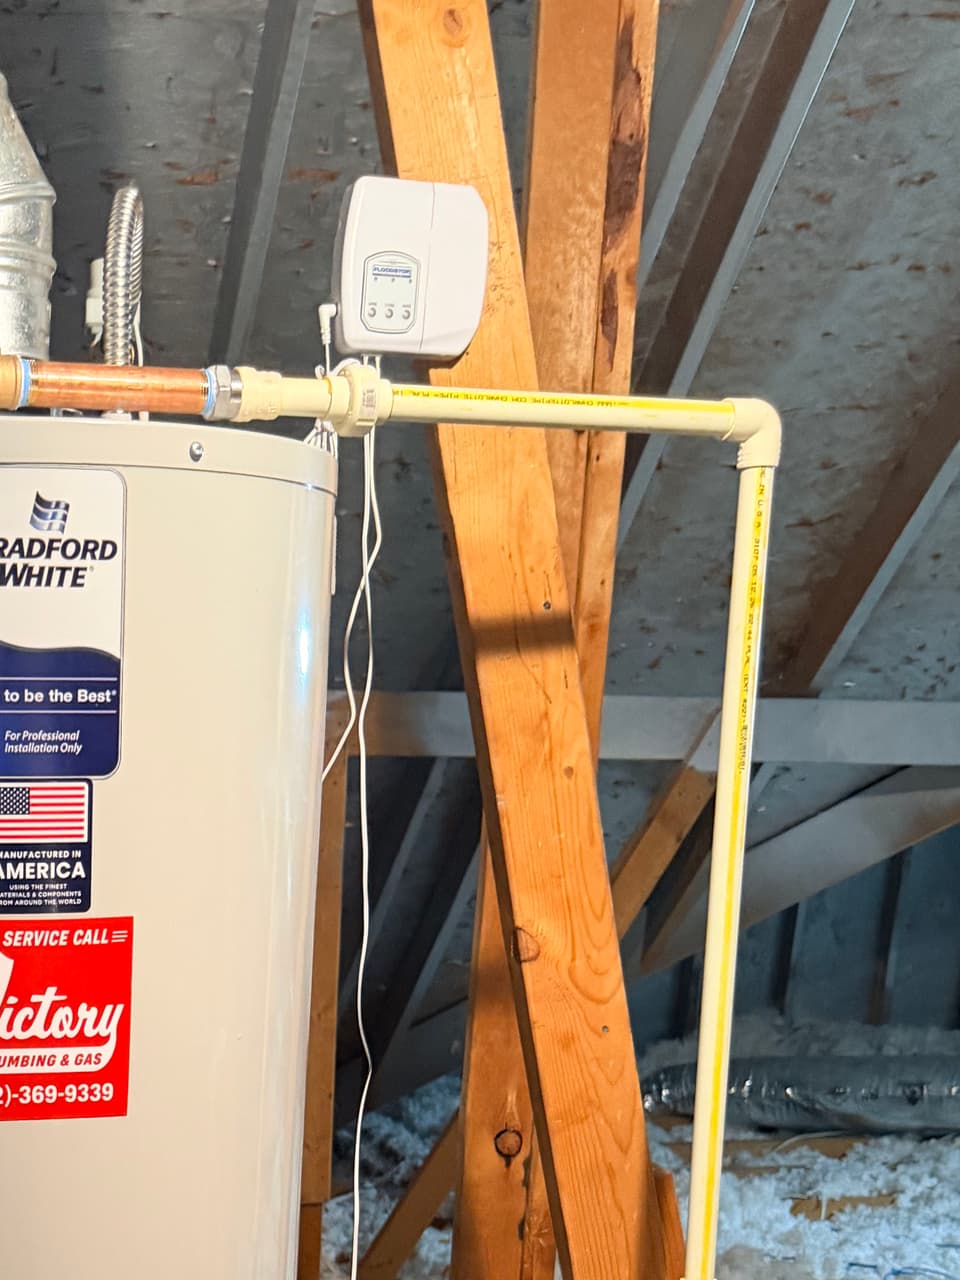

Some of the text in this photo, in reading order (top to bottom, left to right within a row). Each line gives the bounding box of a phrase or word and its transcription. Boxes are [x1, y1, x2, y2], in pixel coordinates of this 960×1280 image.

[4, 690, 20, 702] to
[24, 689, 44, 702] be
[48, 689, 73, 702] the
[4, 730, 80, 741] For Professional
[4, 742, 82, 755] Installation Only
[2, 930, 70, 946] SERVICE
[73, 928, 109, 945] CALL
[60, 1054, 69, 1066] &
[74, 1053, 102, 1066] GAS
